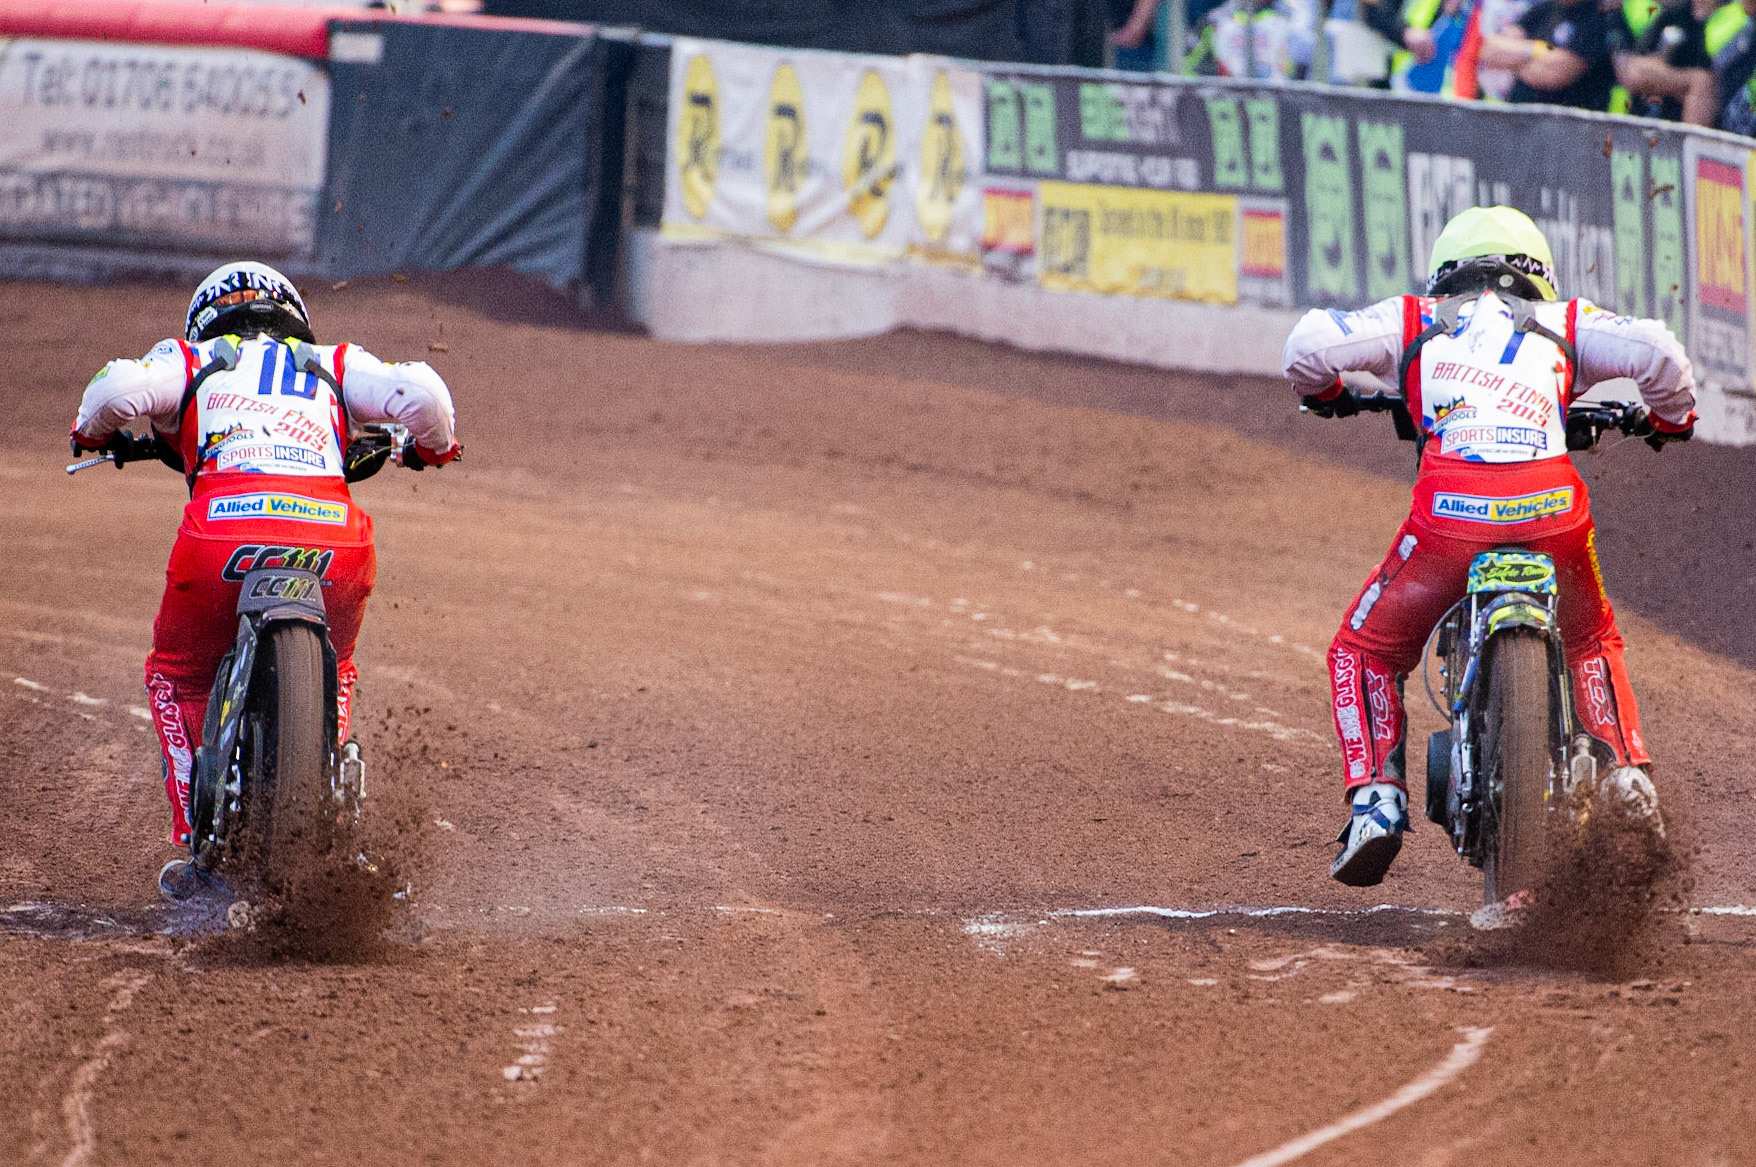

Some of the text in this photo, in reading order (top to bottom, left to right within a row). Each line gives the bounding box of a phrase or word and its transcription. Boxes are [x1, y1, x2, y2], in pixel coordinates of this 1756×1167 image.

[1431, 361, 1506, 392] BRITISH
[206, 391, 331, 446] BRITISH FINAL
[1445, 427, 1547, 449] SPORTS INSURE
[222, 445, 274, 465] SPORTS
[274, 445, 326, 468] INSURE
[213, 498, 341, 519] Allied Vehicles
[1437, 495, 1567, 518] Allied Vehicles
